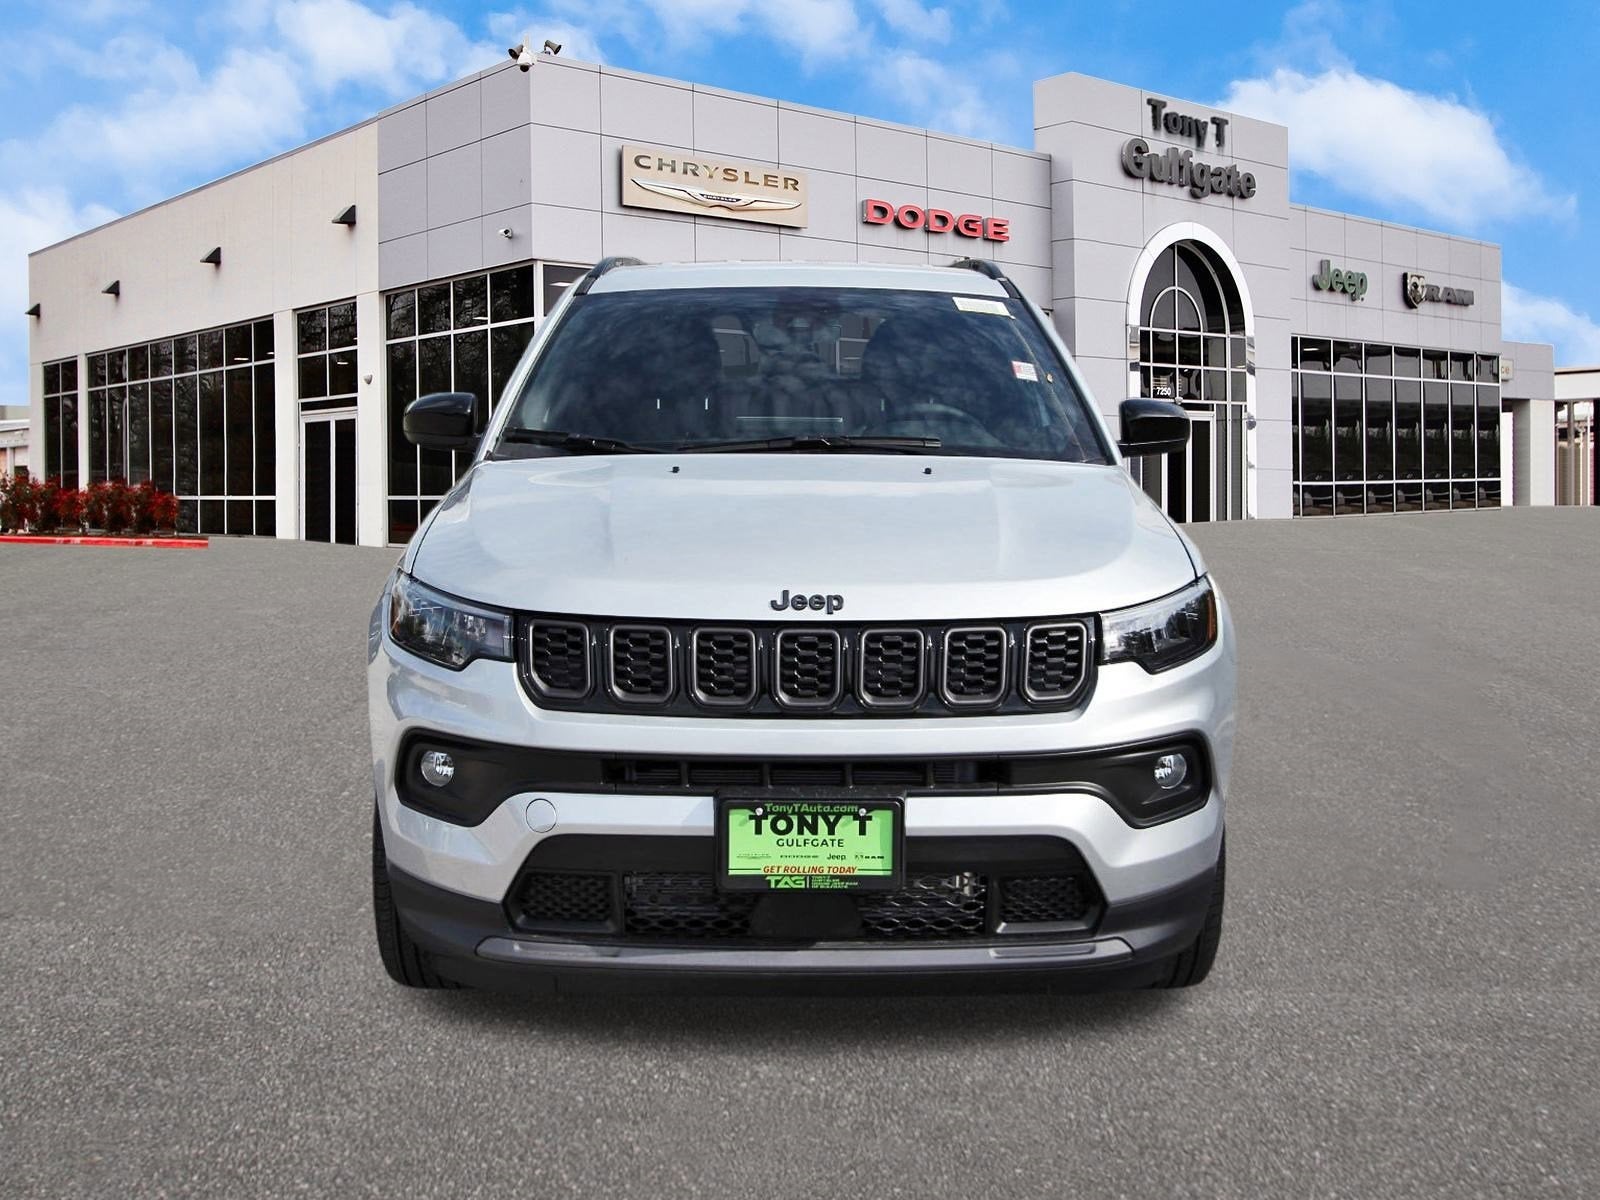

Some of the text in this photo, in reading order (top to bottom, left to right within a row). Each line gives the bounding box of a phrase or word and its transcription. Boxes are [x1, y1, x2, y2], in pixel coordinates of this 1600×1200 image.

[1147, 98, 1229, 147] Tony T
[633, 153, 801, 192] CHRYSLER
[1121, 138, 1256, 199] Gulfgate
[863, 198, 1010, 242] DODGE
[1312, 259, 1368, 302] Jeep
[1424, 284, 1475, 306] RAM
[1156, 386, 1172, 396] 7250
[770, 589, 844, 615] Jeep
[764, 803, 858, 813] TonyTAuto.com
[749, 814, 873, 836] TONY T
[776, 838, 845, 848] GULFGATE
[826, 853, 847, 861] Jeep
[763, 865, 858, 874] GET ROLLING TODAY
[765, 876, 806, 889] TAG
